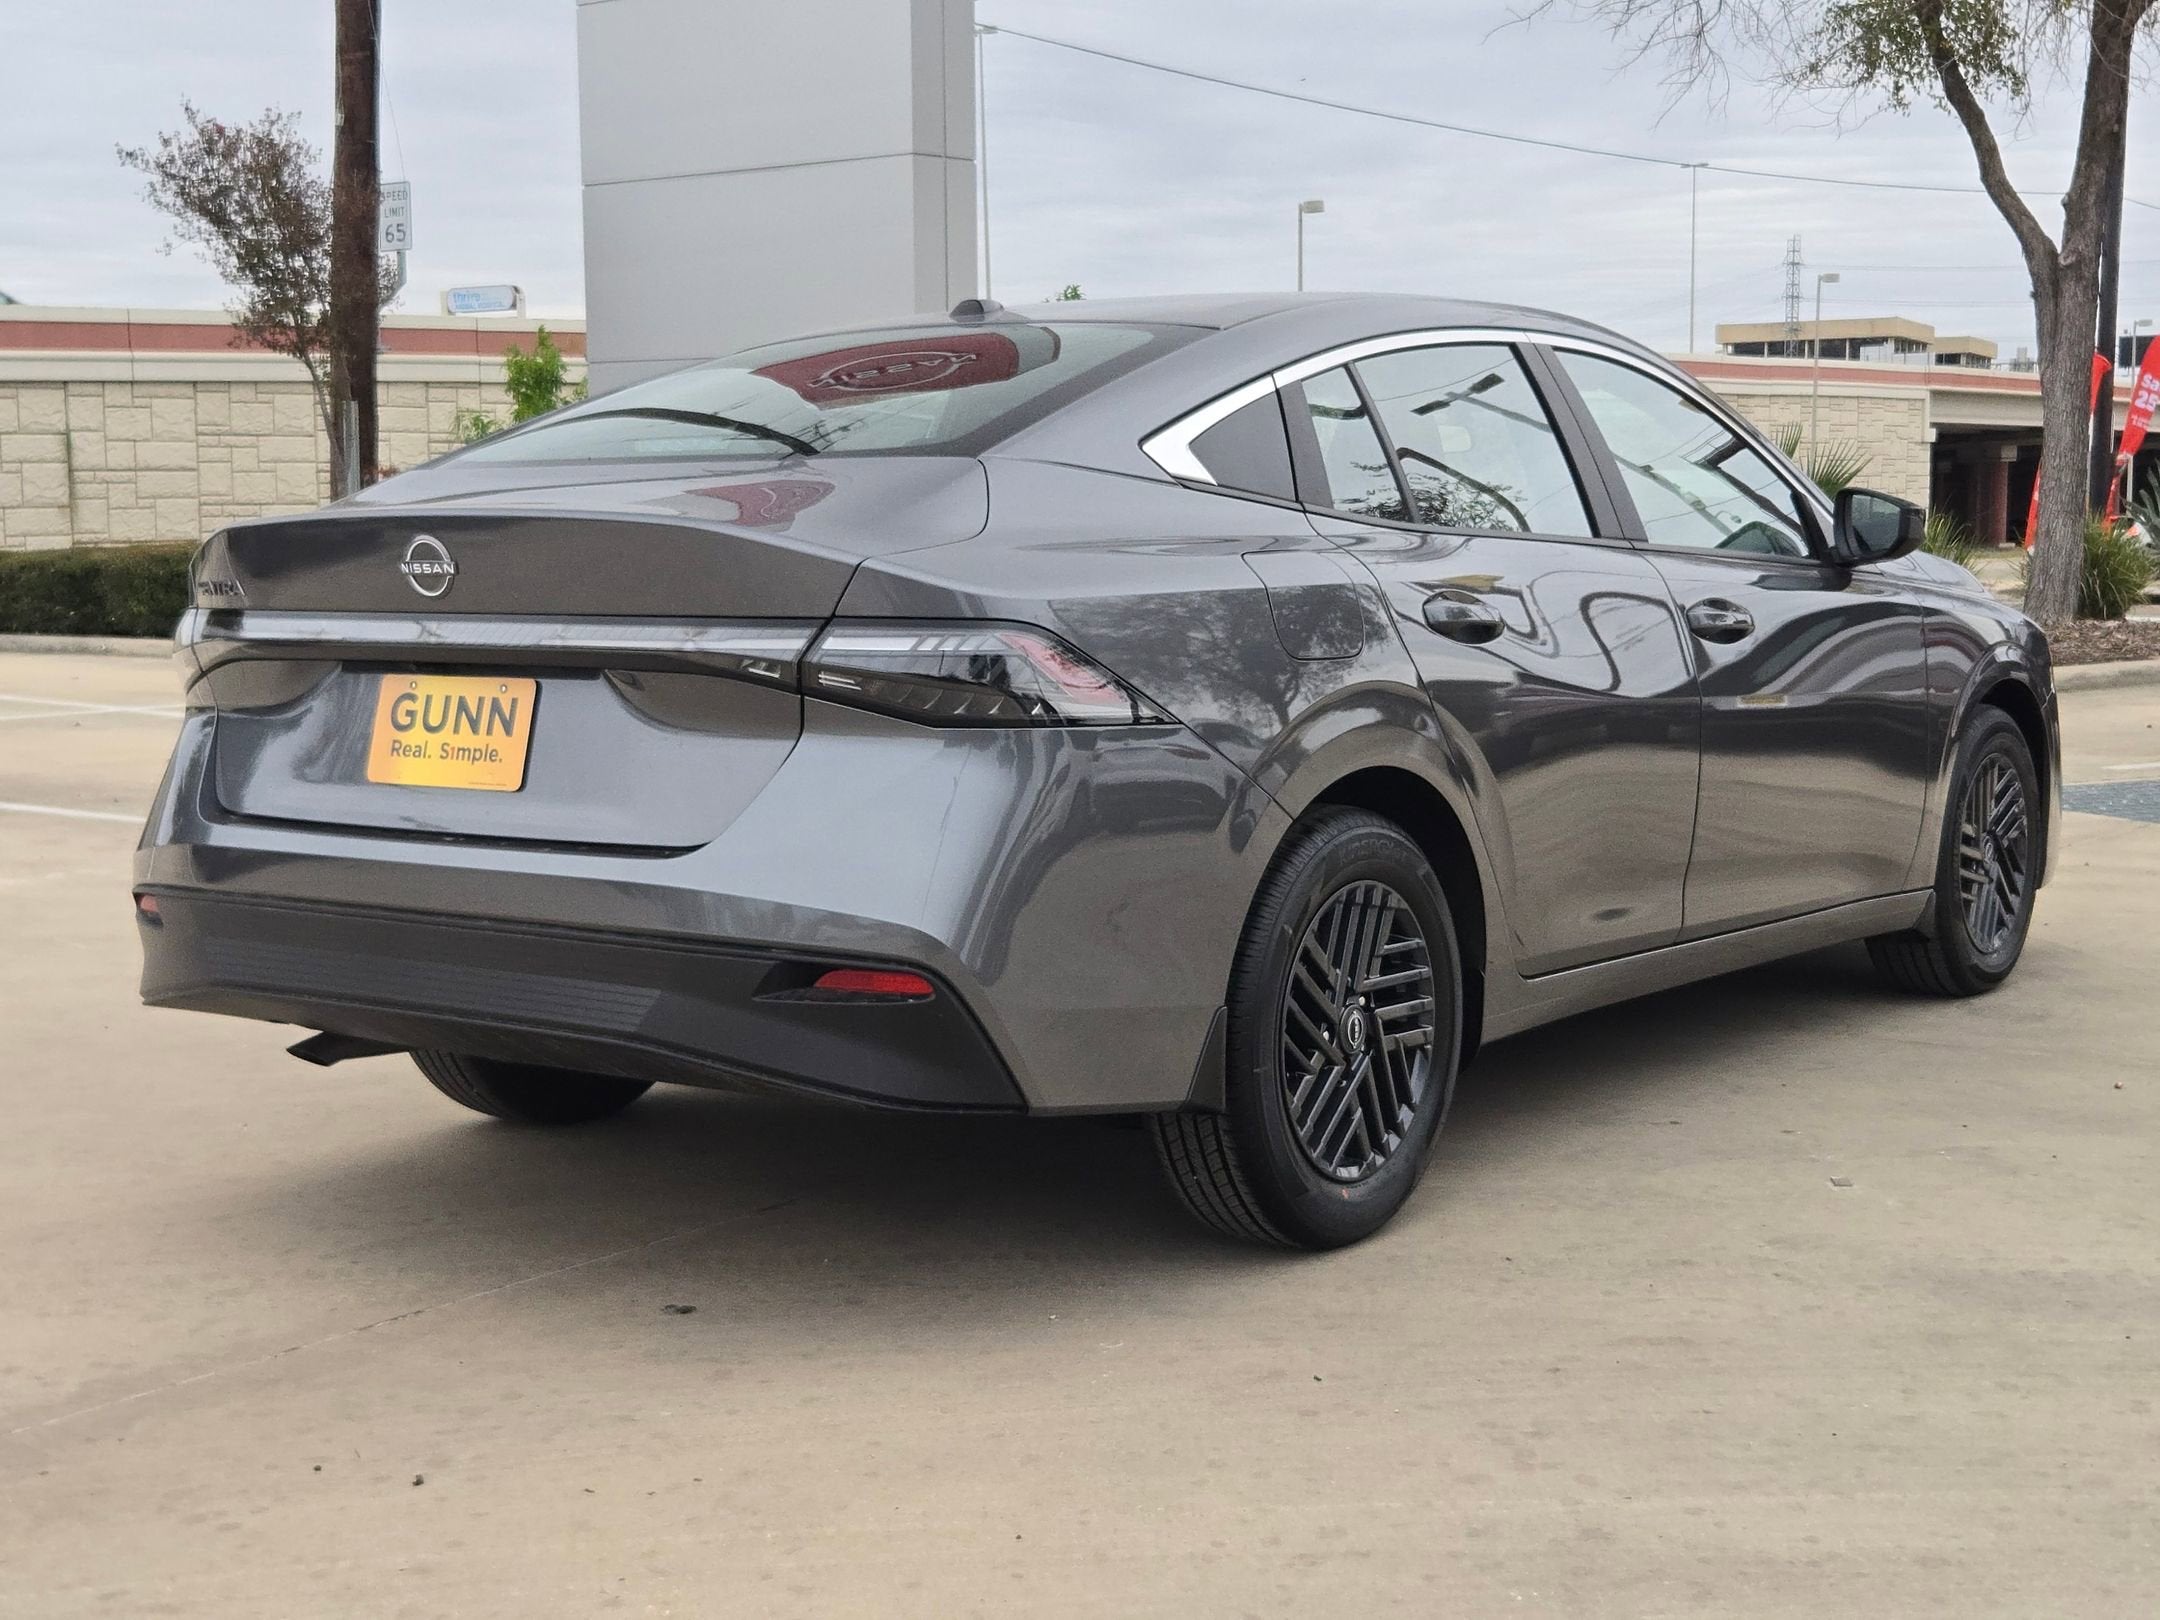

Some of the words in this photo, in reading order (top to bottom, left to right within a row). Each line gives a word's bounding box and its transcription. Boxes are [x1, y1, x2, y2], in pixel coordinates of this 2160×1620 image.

[384, 207, 405, 218] LIMIT
[385, 223, 406, 243] 65
[401, 563, 455, 574] NISSAN
[390, 692, 519, 738] GUNN
[390, 739, 432, 759] Real.
